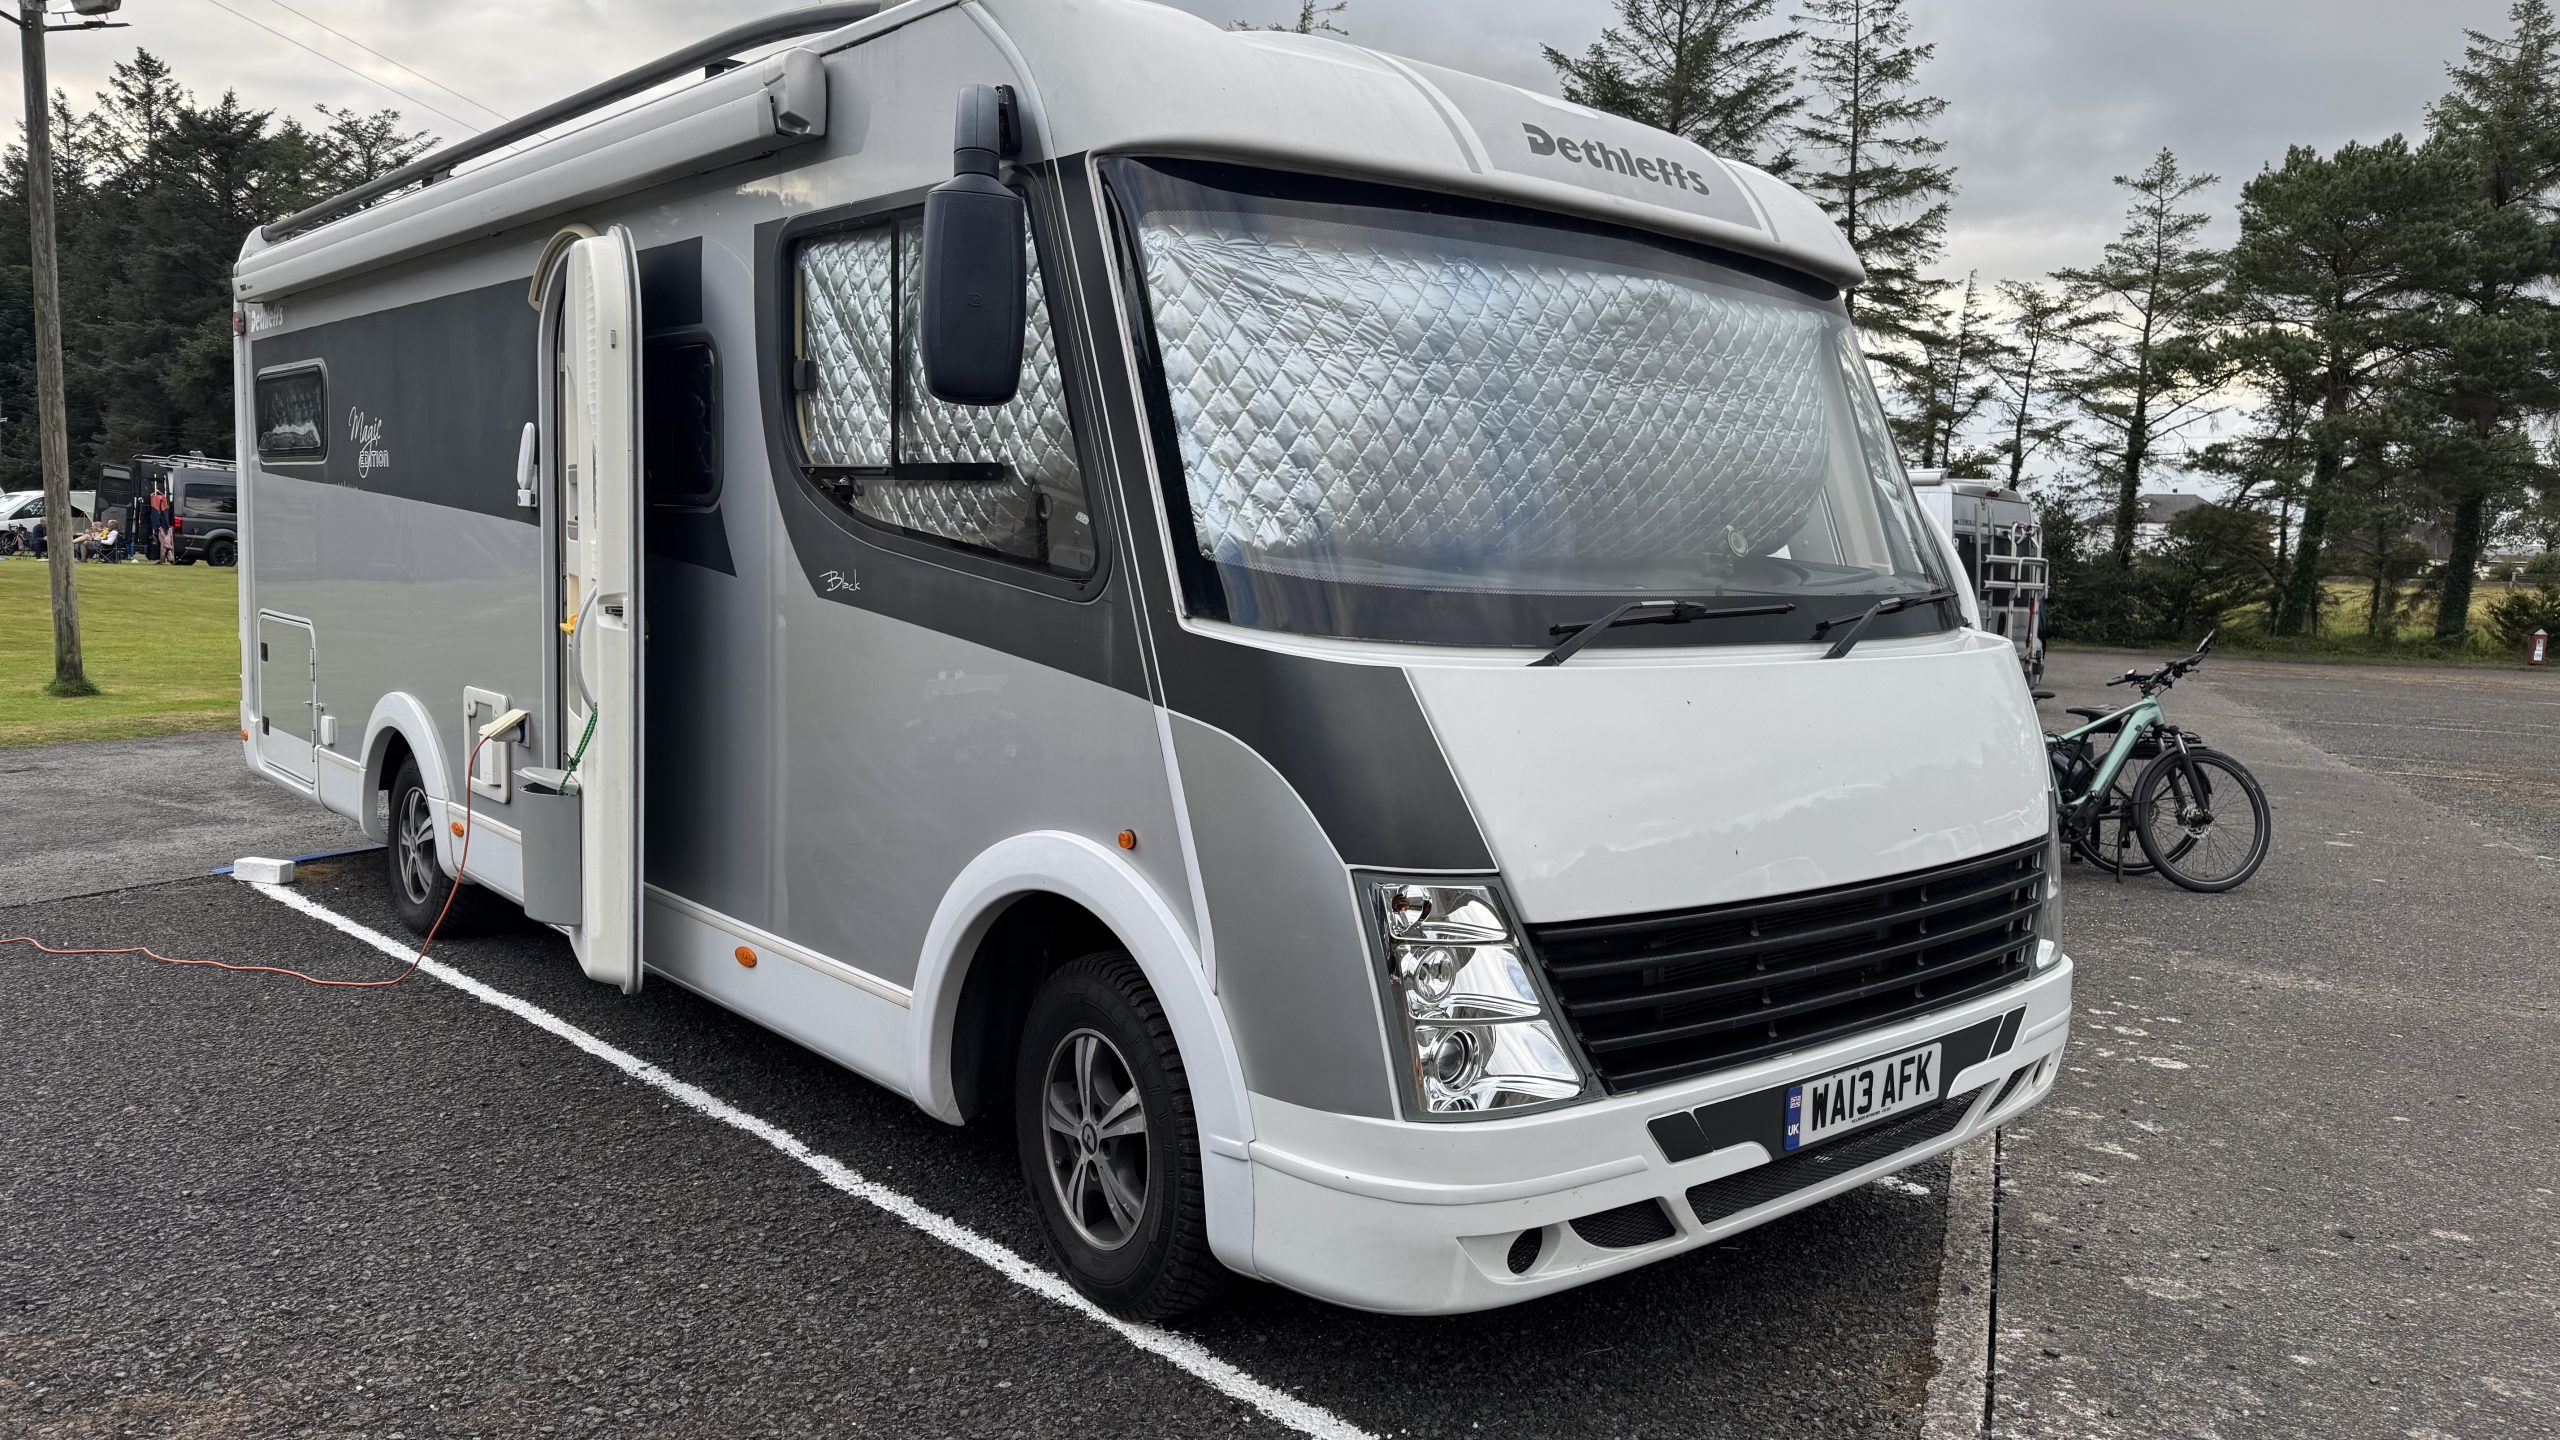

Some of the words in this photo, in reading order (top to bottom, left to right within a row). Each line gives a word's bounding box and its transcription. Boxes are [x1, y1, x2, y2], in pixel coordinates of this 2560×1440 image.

[1521, 121, 1710, 196] Dethleffs
[348, 406, 382, 478] Magic
[819, 568, 861, 592] Black
[1811, 1069, 1874, 1132] WA13
[1880, 1050, 1933, 1108] AFK
[1787, 1123, 1800, 1136] UK
